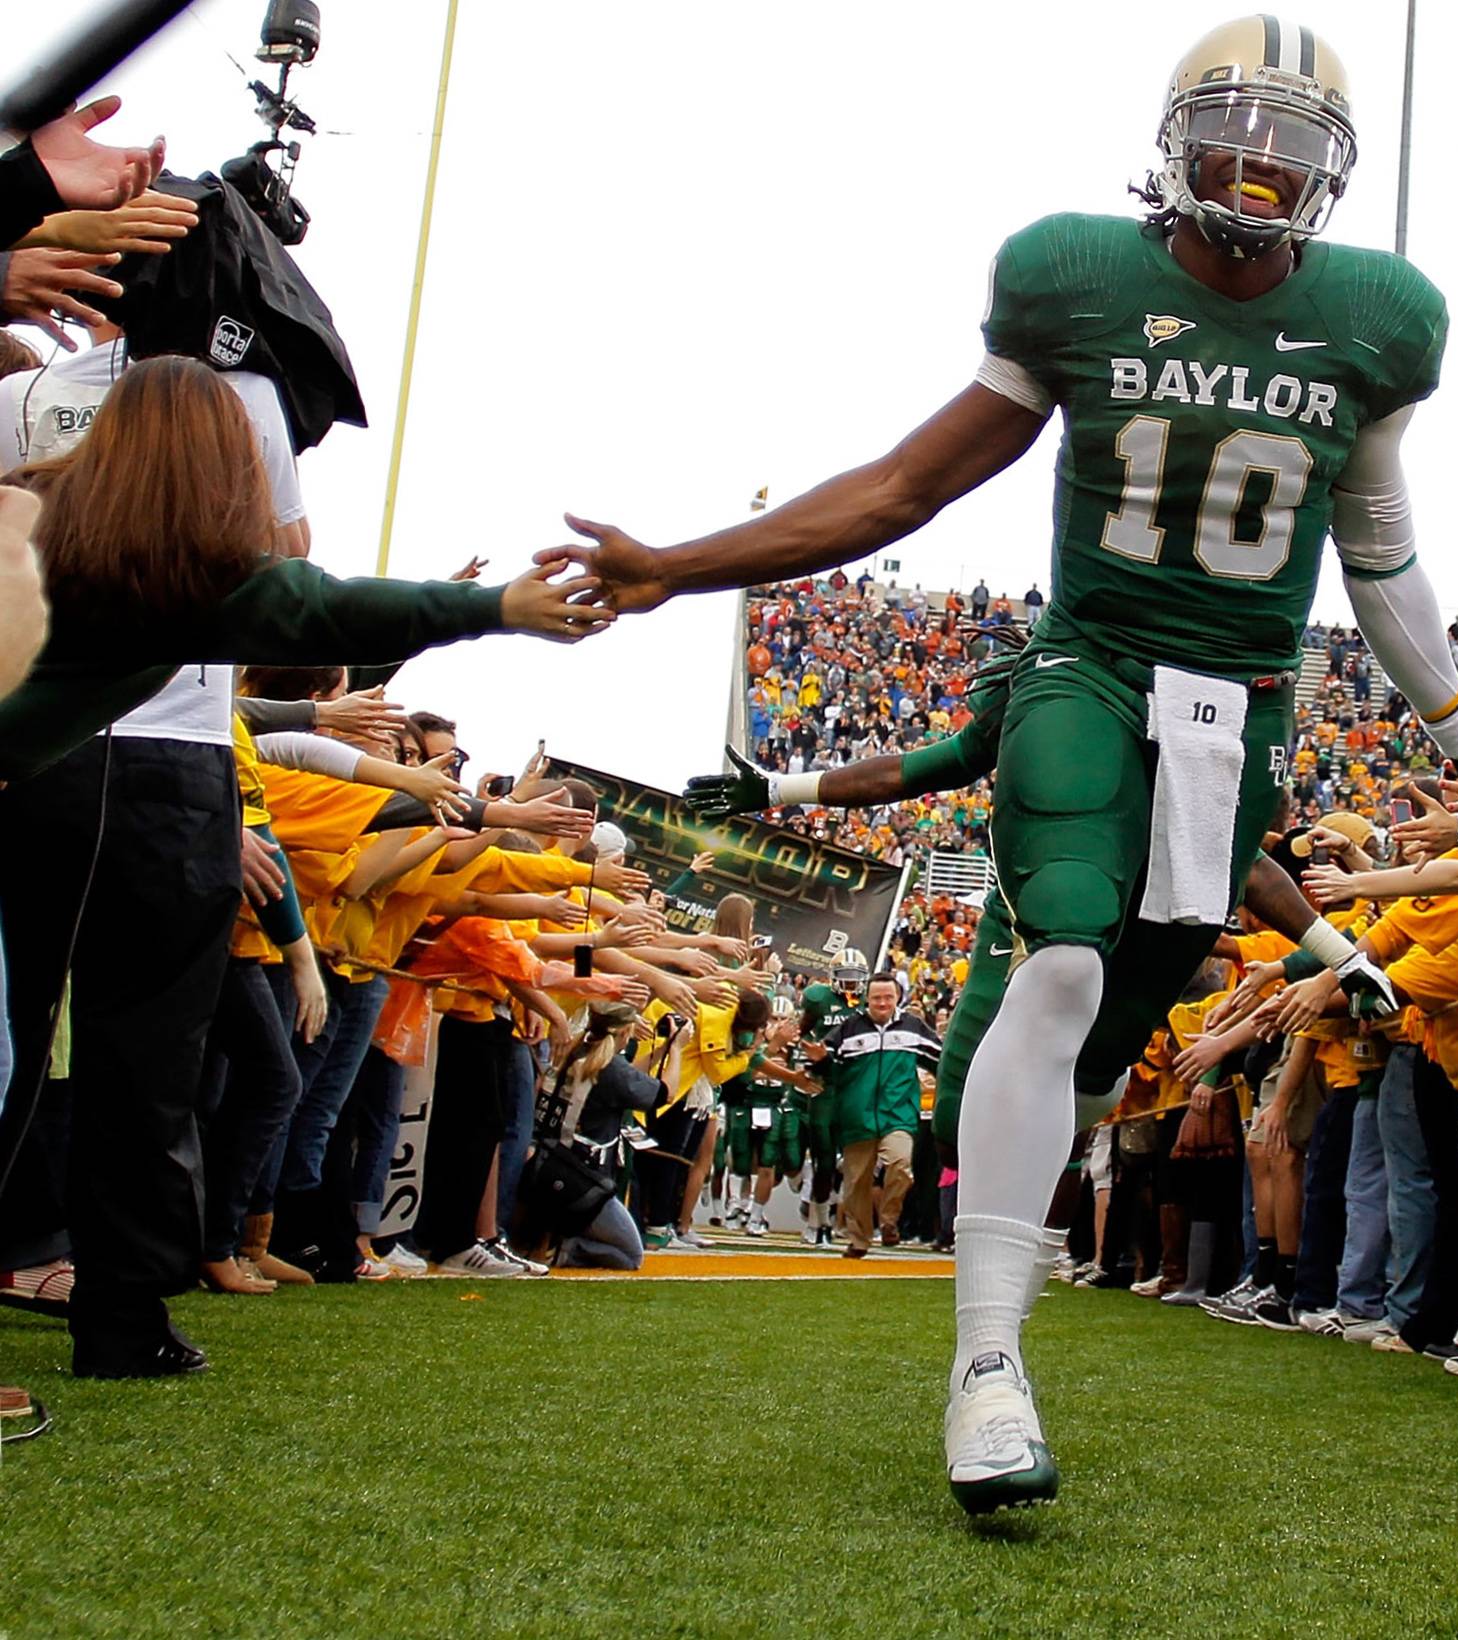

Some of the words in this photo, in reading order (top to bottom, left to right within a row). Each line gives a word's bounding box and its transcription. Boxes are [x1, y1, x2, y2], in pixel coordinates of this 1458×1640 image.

[215, 328, 246, 352] porta
[213, 343, 240, 365] brace
[1110, 357, 1337, 427] BAYLOR
[53, 405, 98, 435] BA
[1100, 414, 1314, 581] 10
[1192, 701, 1217, 725] 10
